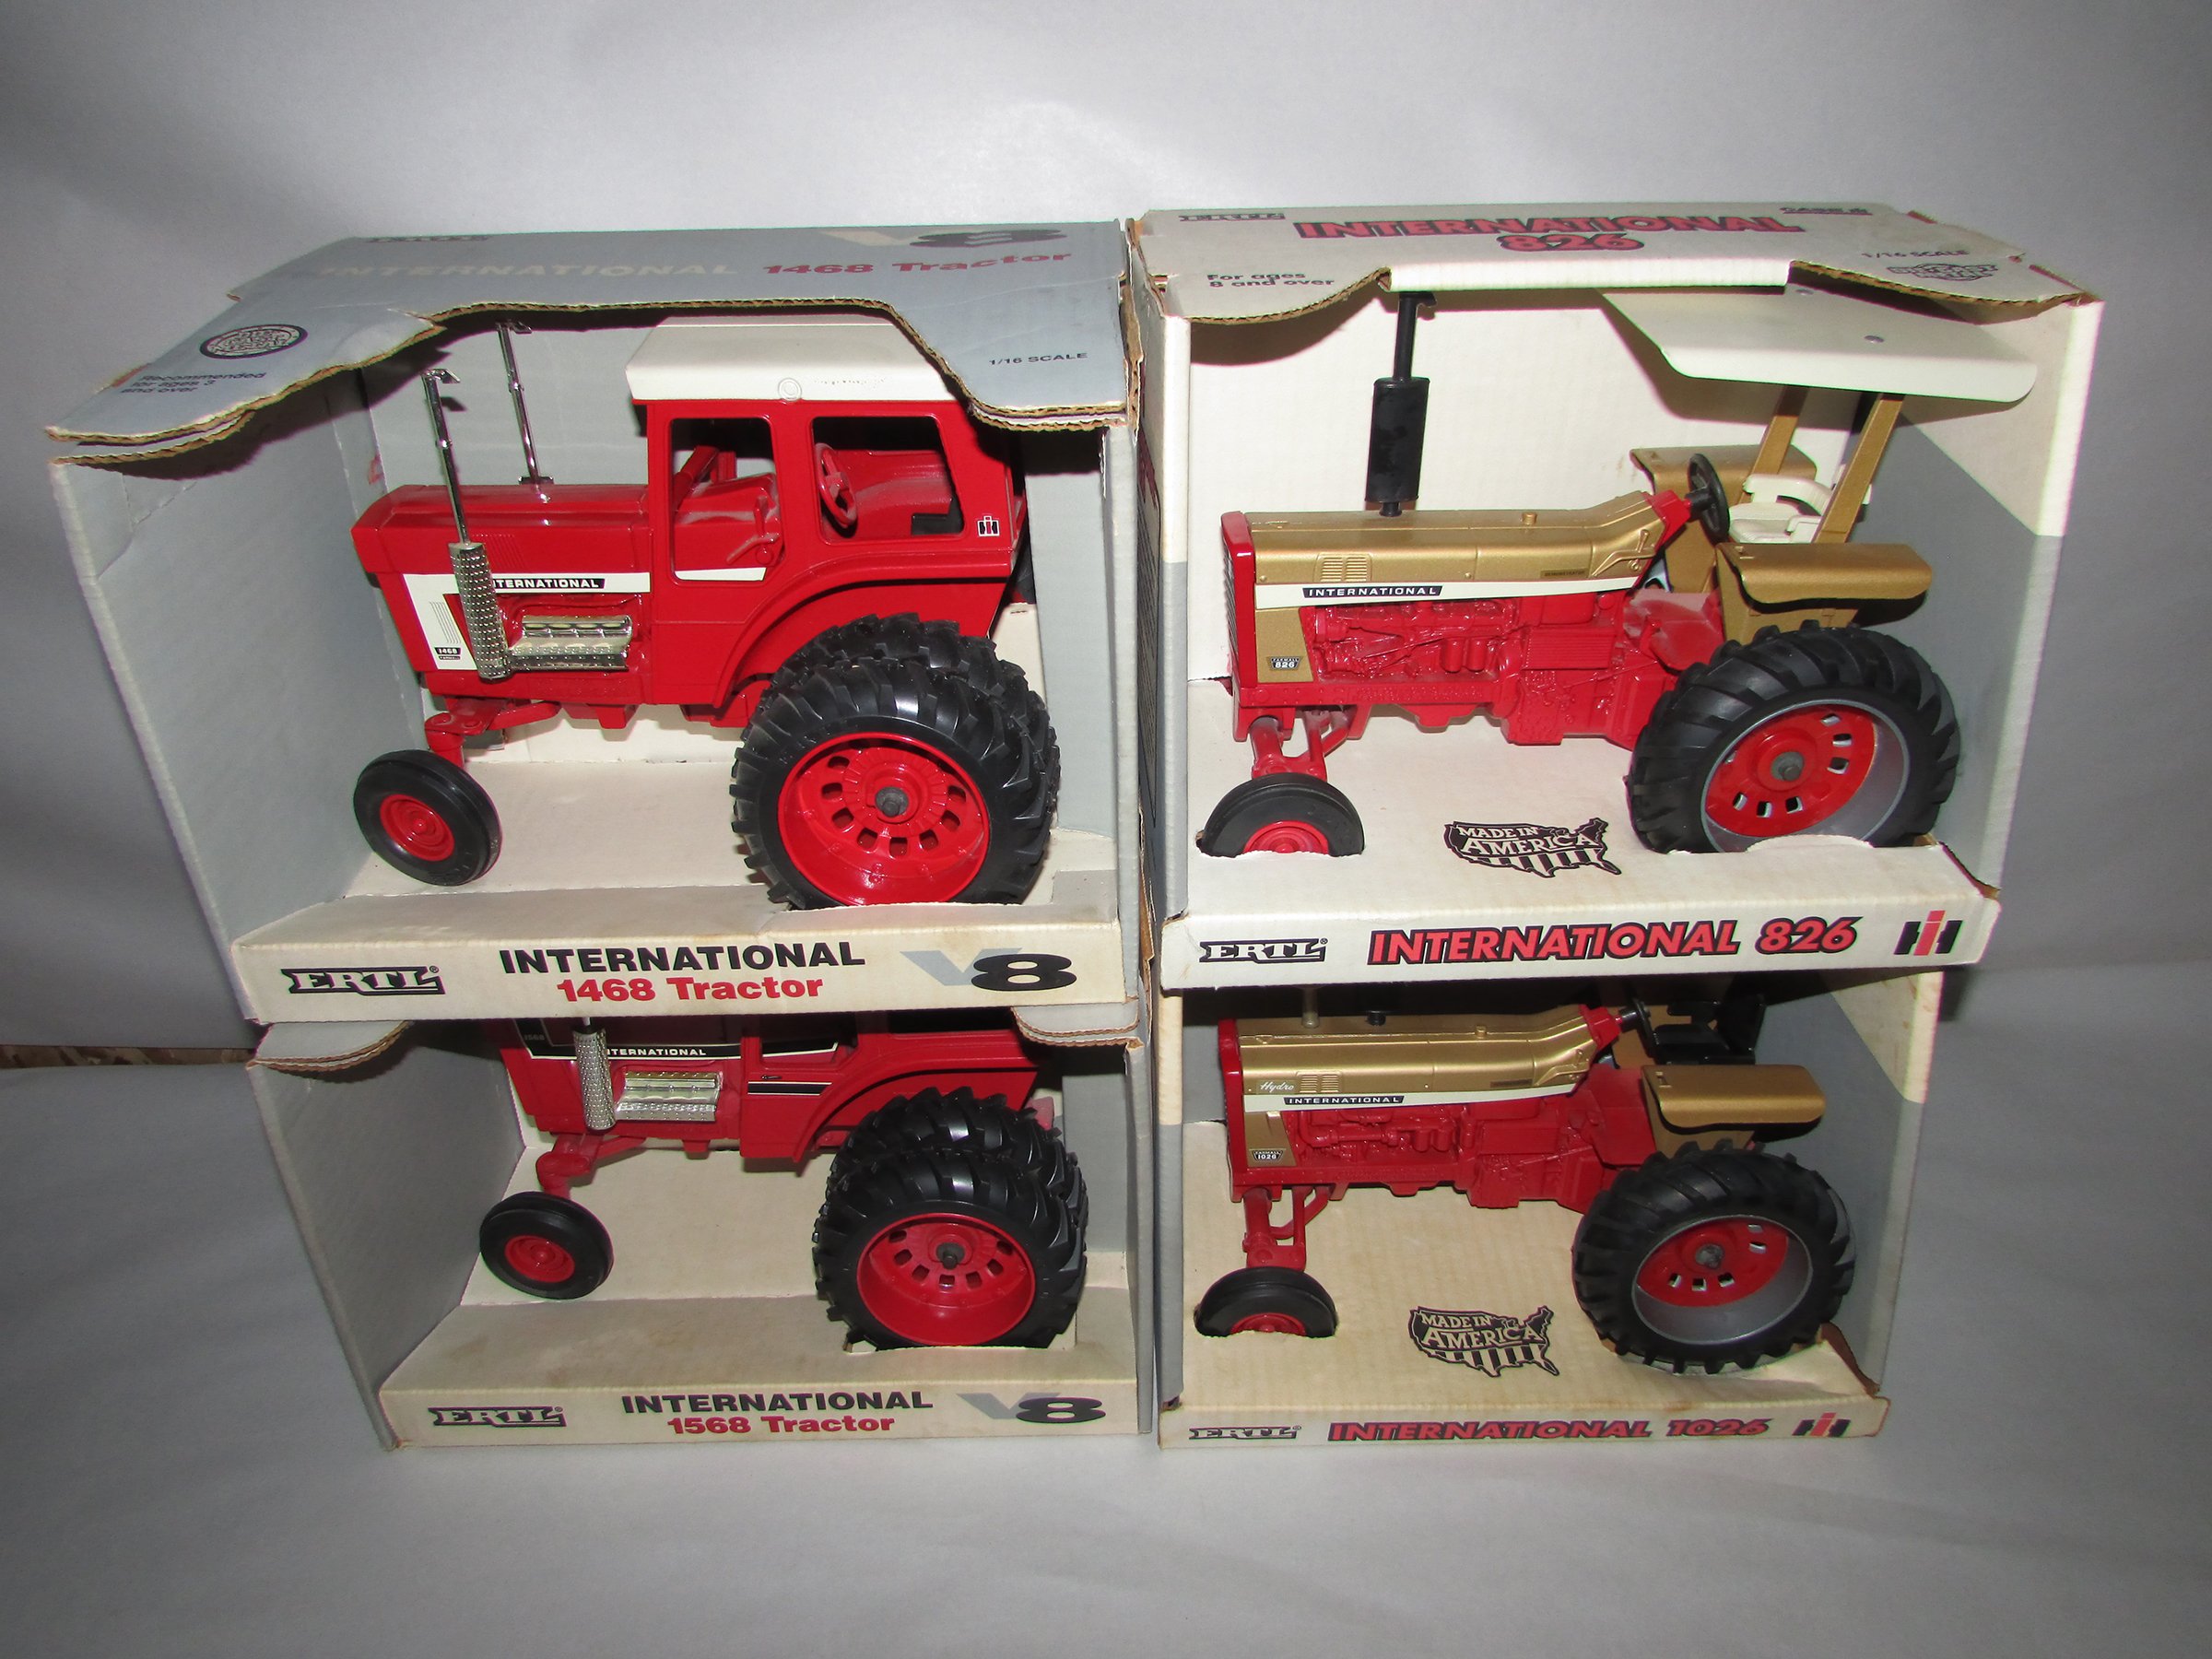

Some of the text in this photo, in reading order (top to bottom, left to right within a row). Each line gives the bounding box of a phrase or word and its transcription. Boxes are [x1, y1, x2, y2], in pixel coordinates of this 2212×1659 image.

[1292, 217, 1805, 239] INTERNATIONAL
[1496, 233, 1645, 253] 826
[762, 264, 874, 275] 1468
[891, 253, 1072, 272] Tractor
[1231, 279, 1277, 288] and
[1251, 273, 1306, 281] ages
[989, 352, 1088, 366] 1/16 SCALE
[493, 579, 599, 588] TERNATIONAL
[1308, 586, 1437, 597] INTERNATIONAL
[1459, 826, 1539, 838] MADE IN
[1461, 833, 1599, 856] AMERICA
[1367, 916, 1864, 965] INTERNATIONAL 826
[499, 941, 866, 973] INTERNATIONAL
[557, 974, 823, 1002] 1468 Tractor
[607, 1048, 706, 1056] TERNATIONAL
[1260, 1081, 1295, 1093] Hydro
[1288, 1096, 1400, 1104] INTERNATIONAL
[1421, 1312, 1492, 1328] MADE IN
[1422, 1324, 1544, 1349] AMERICA
[621, 1391, 934, 1414] INTERNATIONAL
[667, 1415, 895, 1435] 1568 Tractor
[1327, 1418, 1773, 1441] INTERNATIONAL 1026
